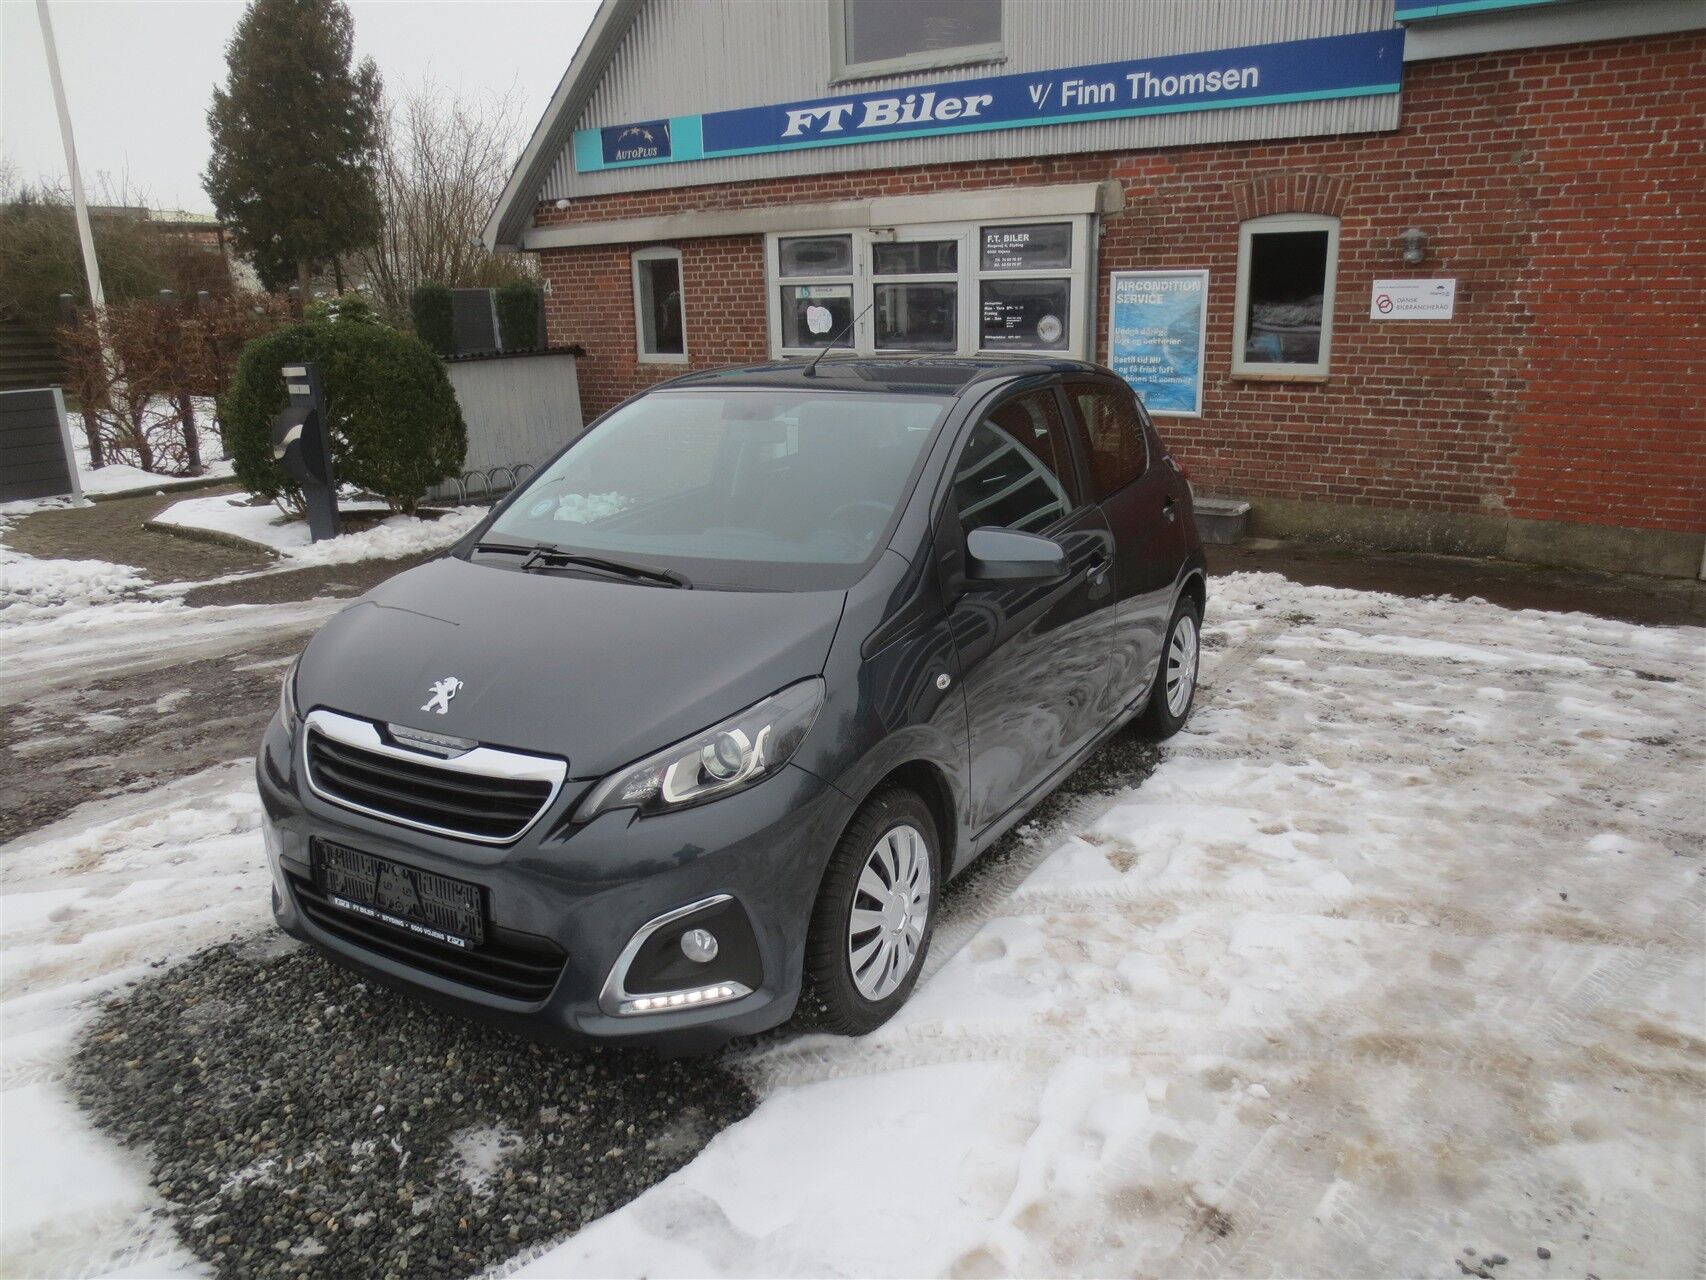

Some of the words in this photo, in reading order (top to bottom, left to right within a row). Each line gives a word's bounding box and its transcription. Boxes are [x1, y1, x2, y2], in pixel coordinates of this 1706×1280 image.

[781, 104, 854, 137] FT
[857, 92, 993, 129] Biler
[1061, 80, 1116, 107] Finn
[1126, 67, 1259, 100] Thomsen
[987, 235, 1001, 243] F.T.
[1003, 233, 1030, 242] BILER
[1116, 280, 1201, 291] AIRCONDITION
[1116, 293, 1164, 304] SERVICE
[1396, 303, 1449, 311] BILBRANCHERÅD
[1139, 366, 1157, 374] frisk
